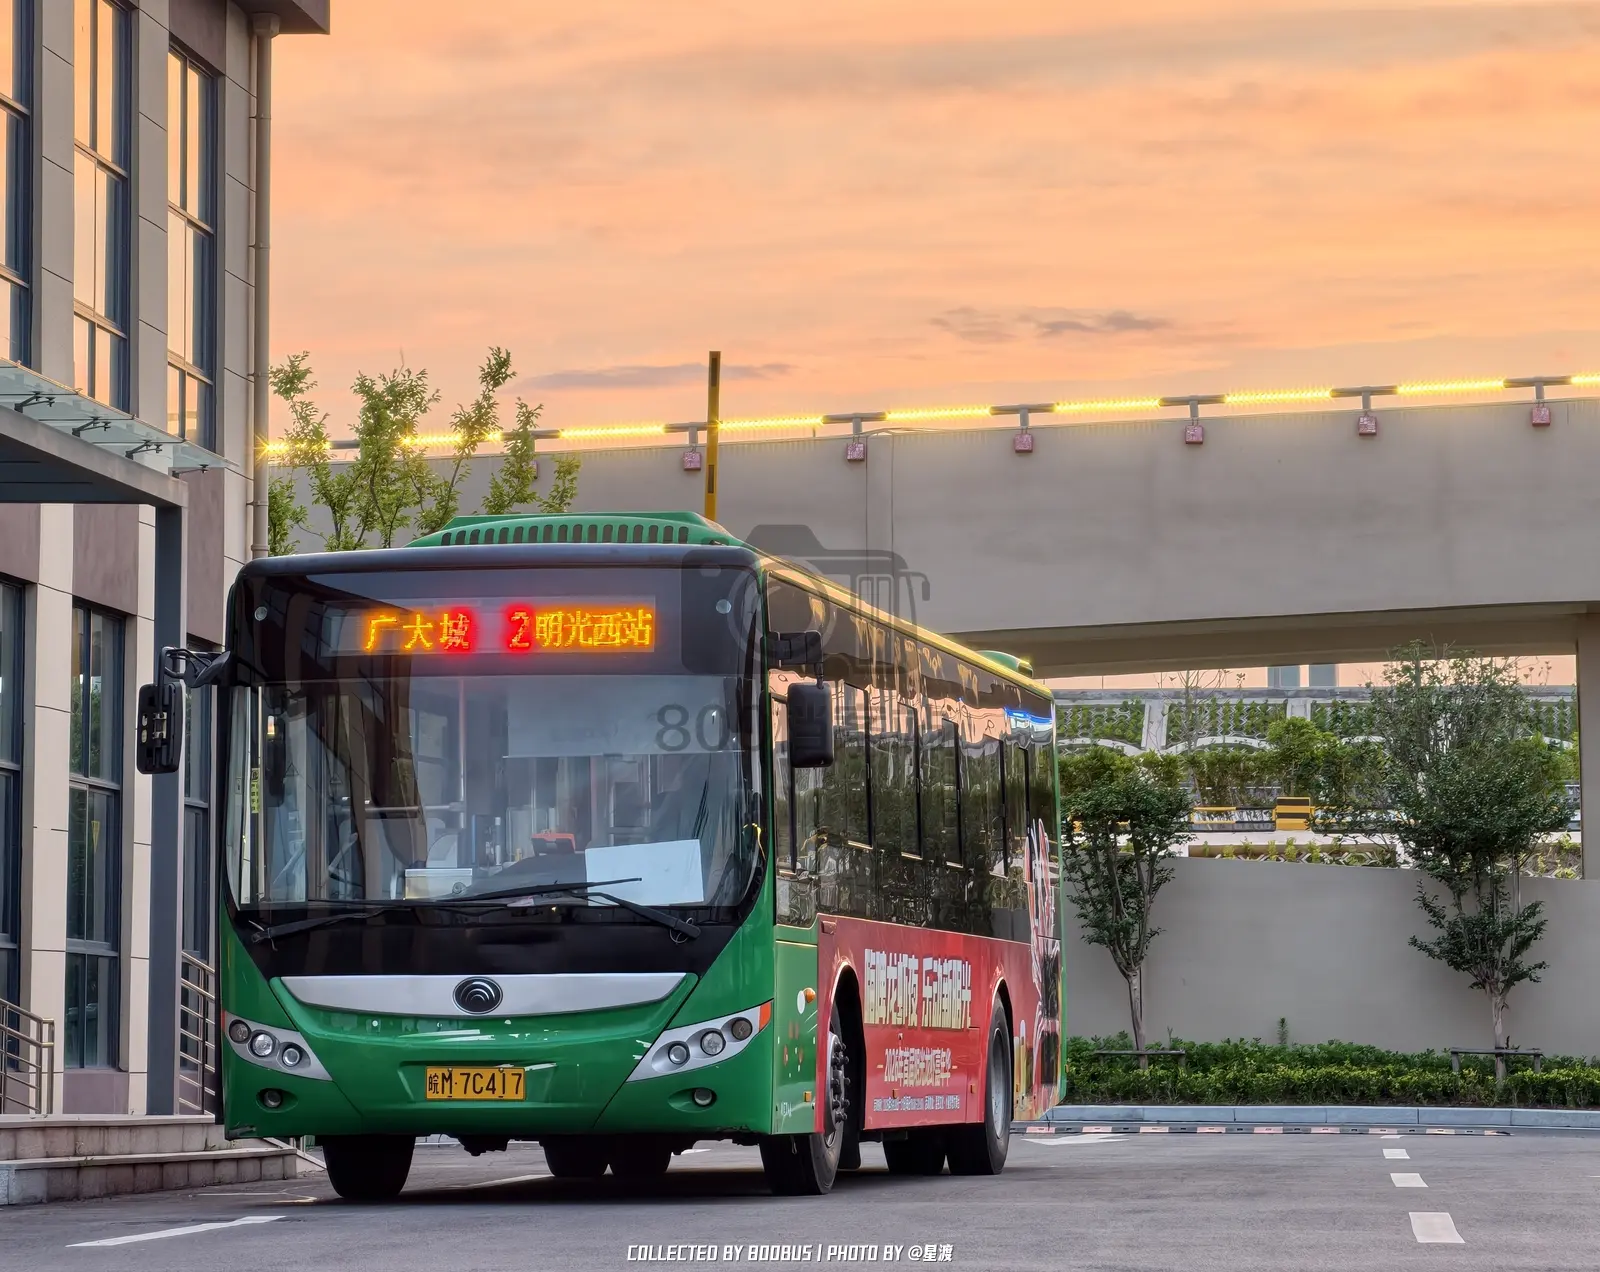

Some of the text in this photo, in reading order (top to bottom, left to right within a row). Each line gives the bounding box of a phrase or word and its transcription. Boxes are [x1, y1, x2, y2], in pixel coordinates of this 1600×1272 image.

[508, 610, 532, 649] 2
[535, 608, 653, 649] 明光西站
